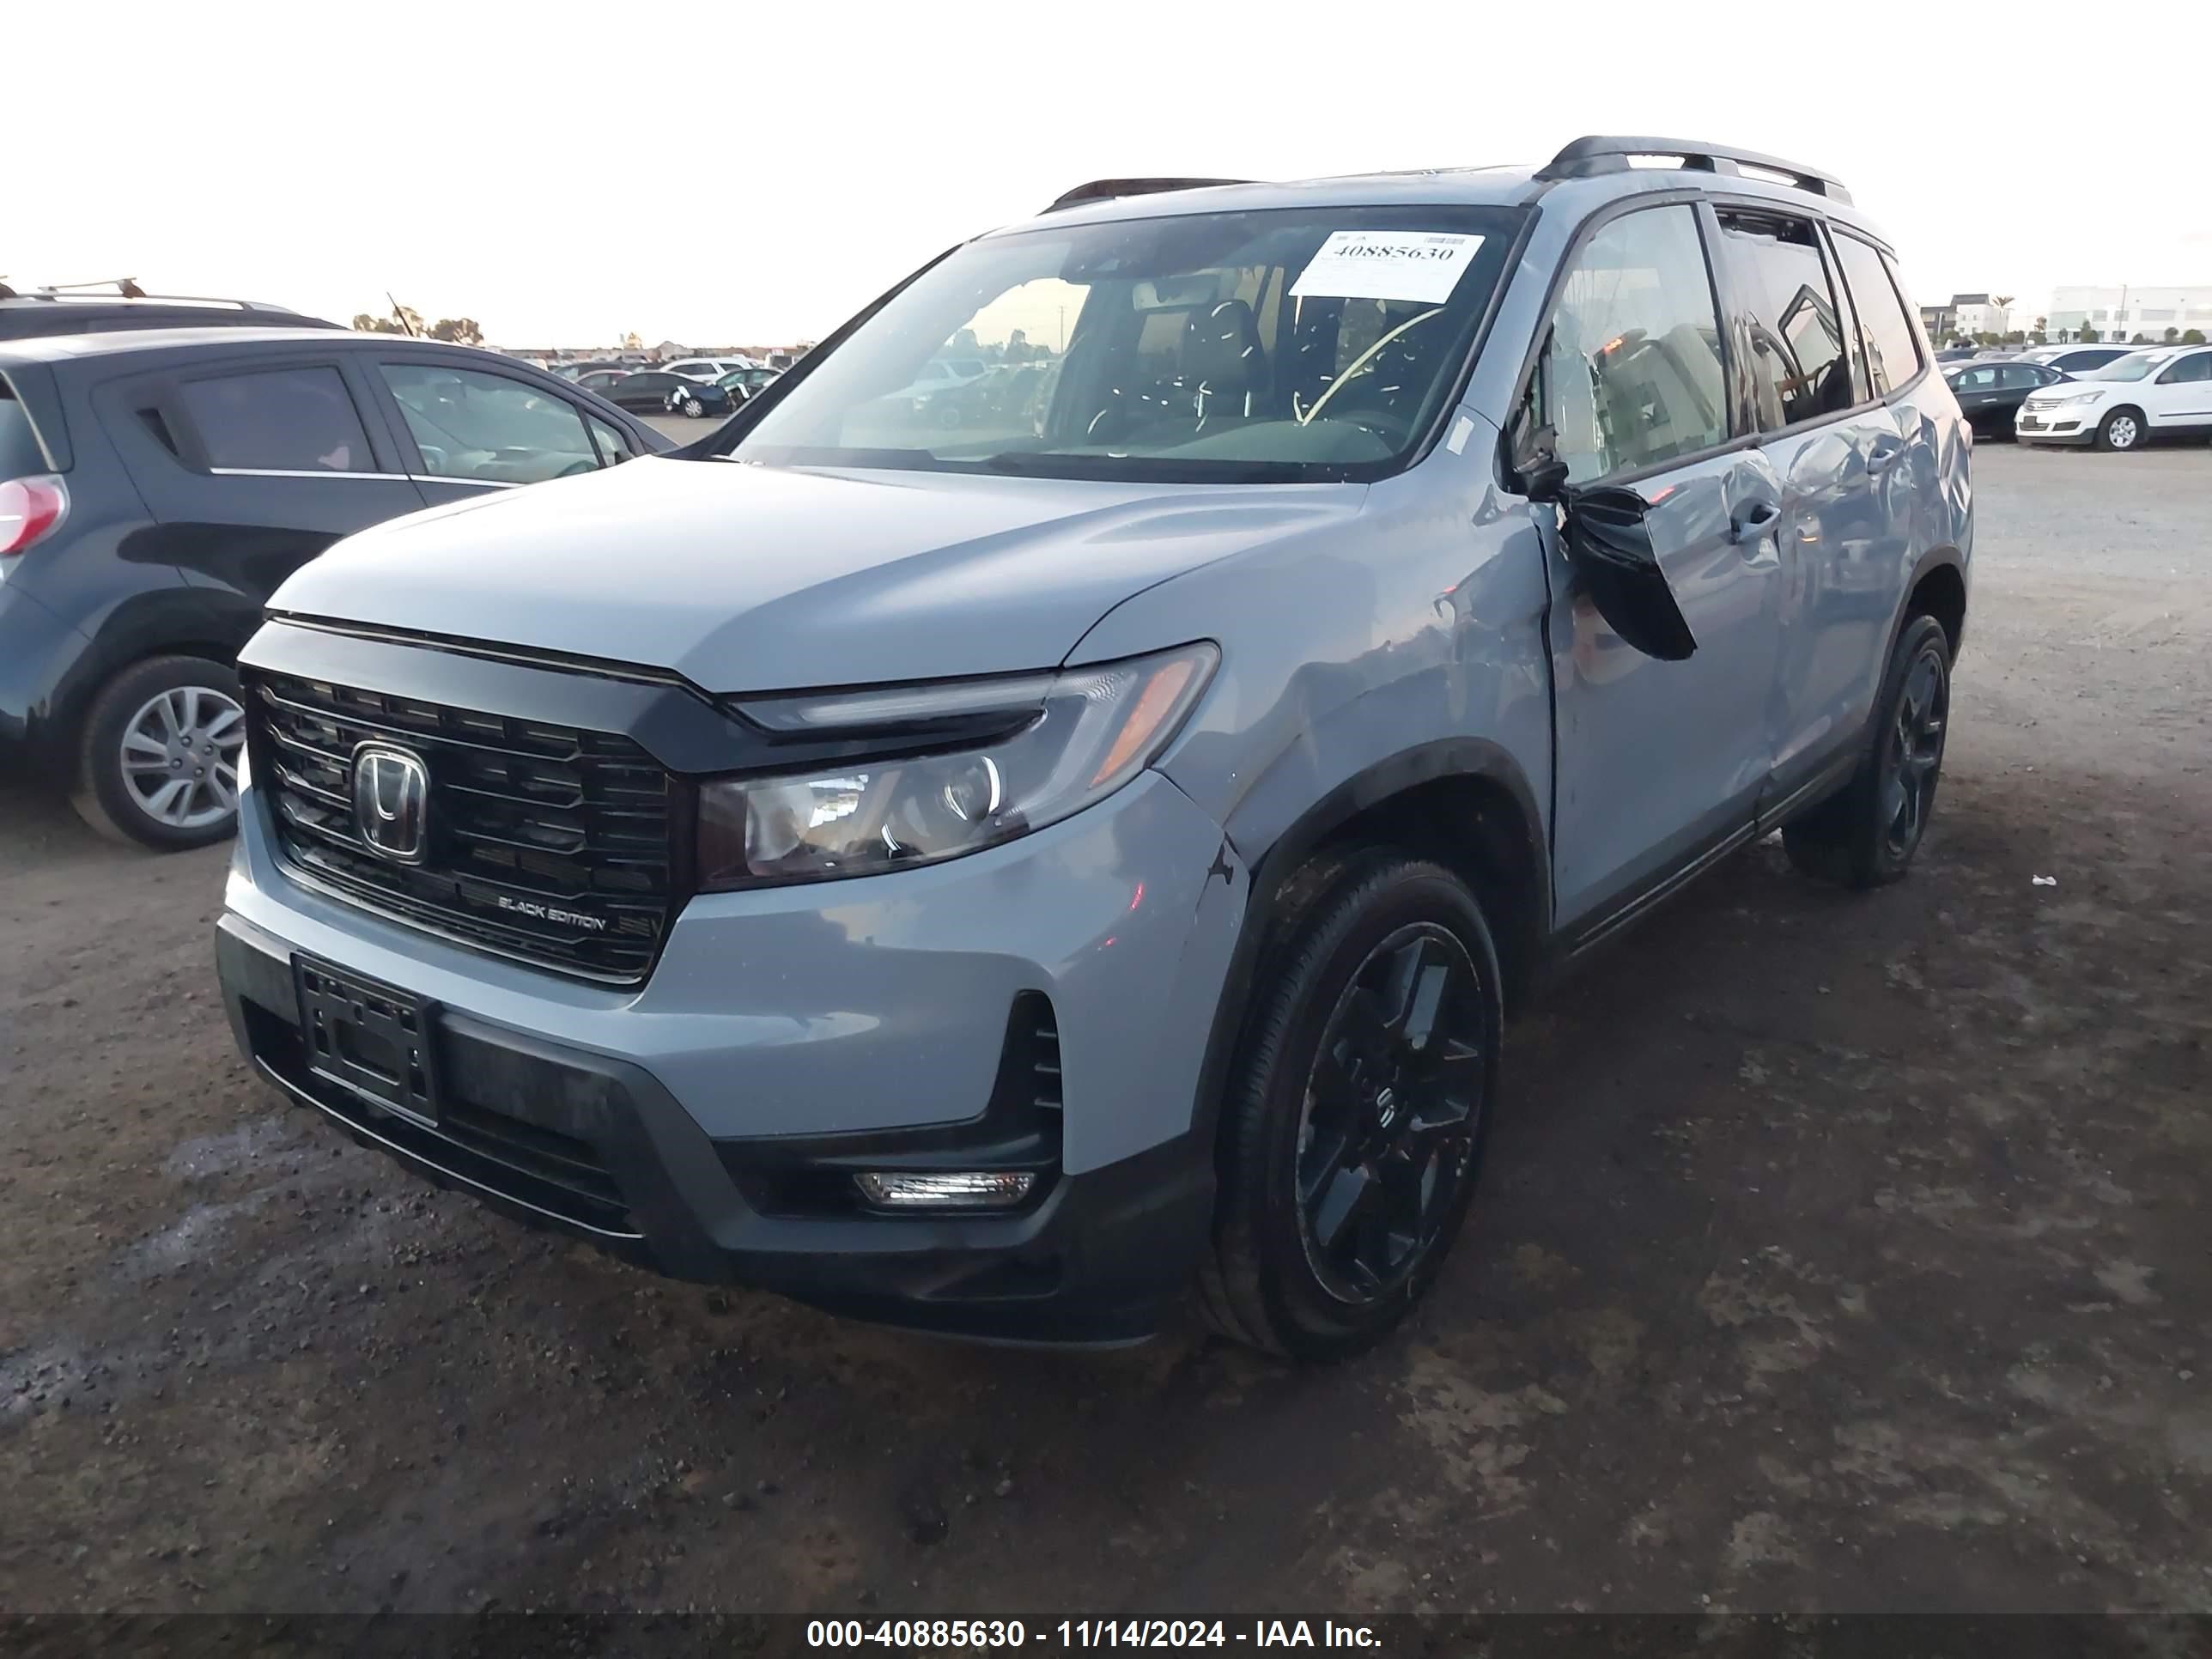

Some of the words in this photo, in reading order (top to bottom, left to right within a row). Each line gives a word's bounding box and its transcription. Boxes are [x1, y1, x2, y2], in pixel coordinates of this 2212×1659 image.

[1334, 245, 1455, 261] 40885630
[498, 896, 546, 919] BLACK
[547, 908, 606, 931] EDITION
